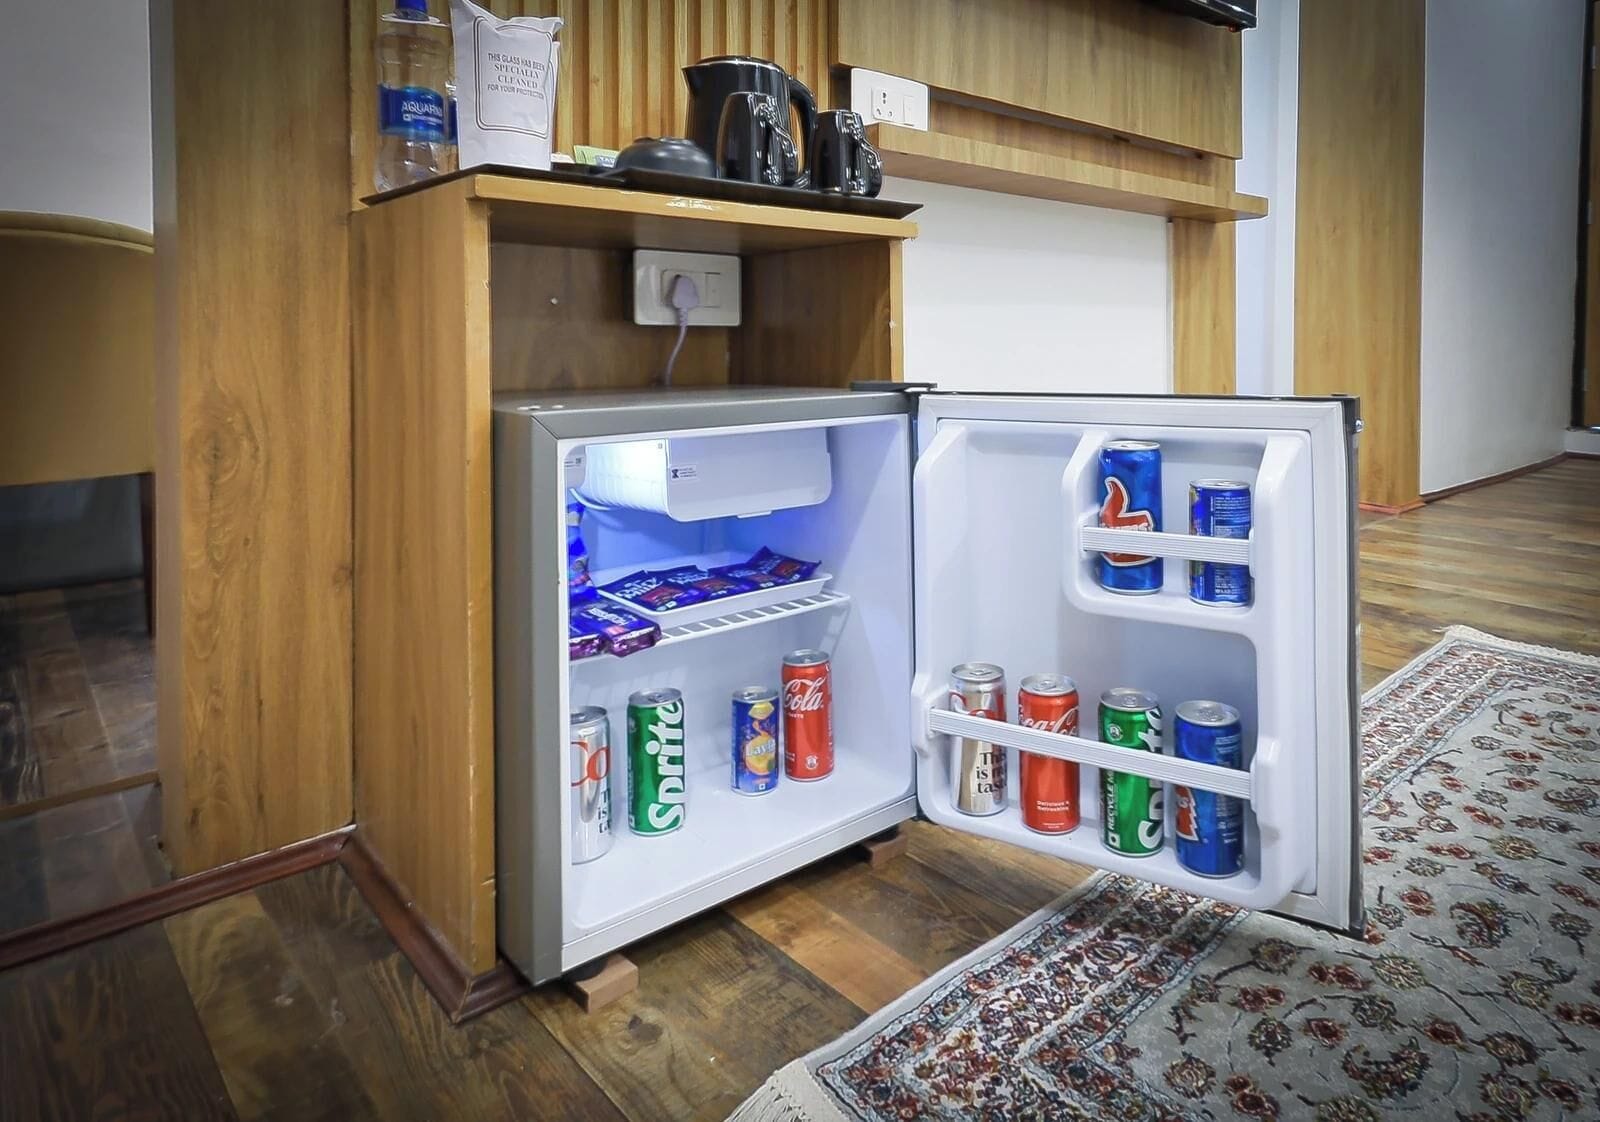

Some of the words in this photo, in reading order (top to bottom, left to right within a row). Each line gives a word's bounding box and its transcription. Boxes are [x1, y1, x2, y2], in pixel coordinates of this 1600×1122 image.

[487, 52, 501, 62] THIS
[502, 54, 520, 65] GLASS
[521, 57, 532, 68] HAS
[533, 61, 545, 71] BEEN
[494, 63, 540, 79] SPECIALLY
[487, 83, 499, 92] FOR
[500, 85, 515, 94] YOUR
[497, 74, 538, 89] CLEANED
[645, 700, 685, 829] Sprite
[1106, 783, 1116, 831] RECYCLE
